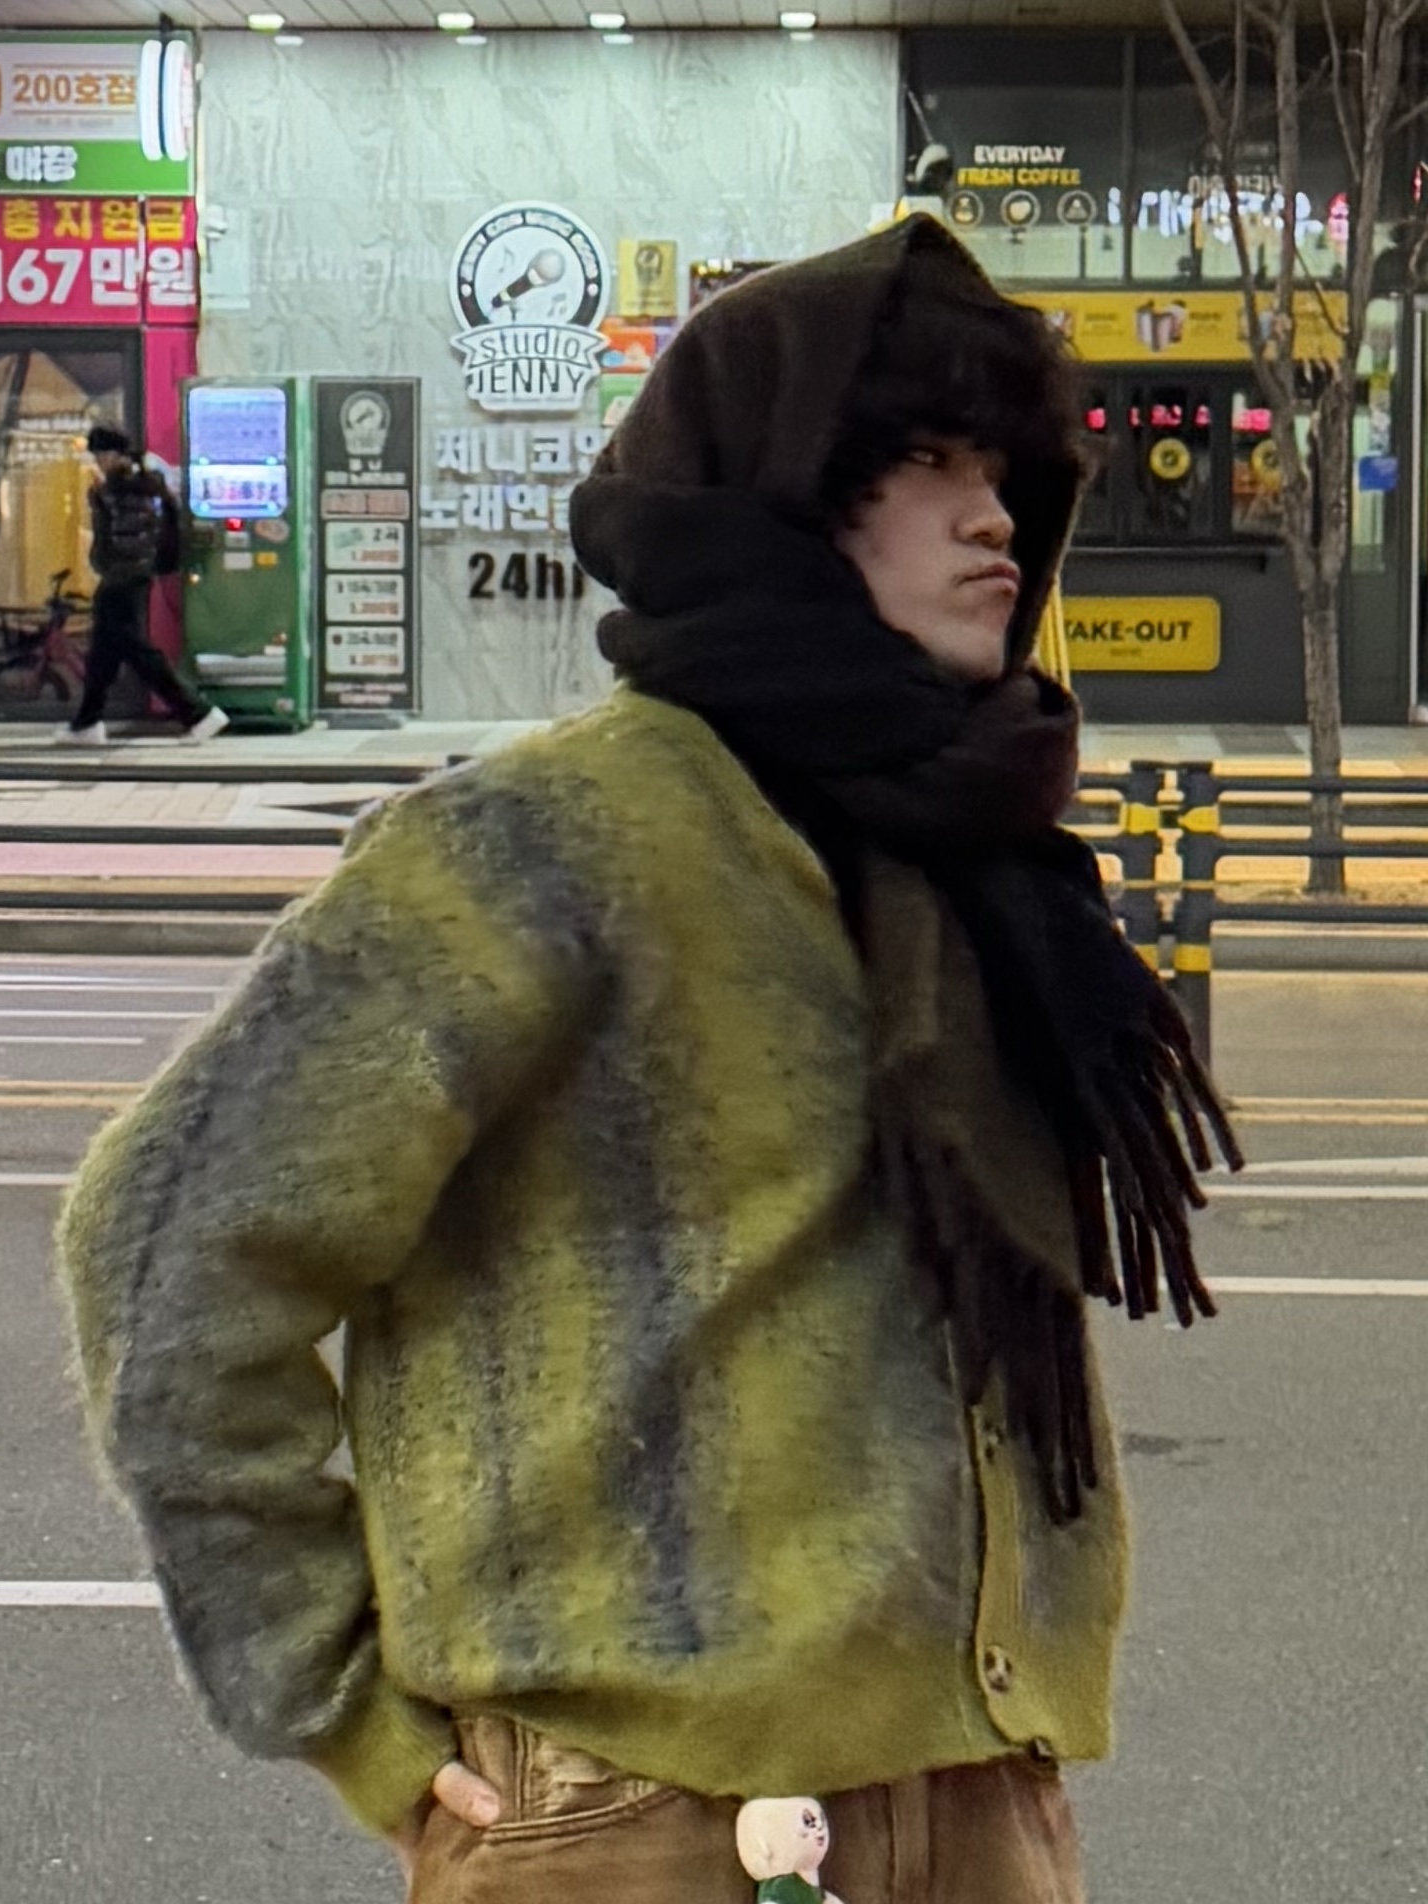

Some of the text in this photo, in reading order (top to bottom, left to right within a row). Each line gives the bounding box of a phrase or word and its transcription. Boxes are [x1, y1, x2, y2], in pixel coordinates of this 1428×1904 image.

[974, 146, 1065, 163] EVERYDAY
[956, 168, 1080, 185] FRESH COFFEE
[475, 361, 585, 395] JENNY
